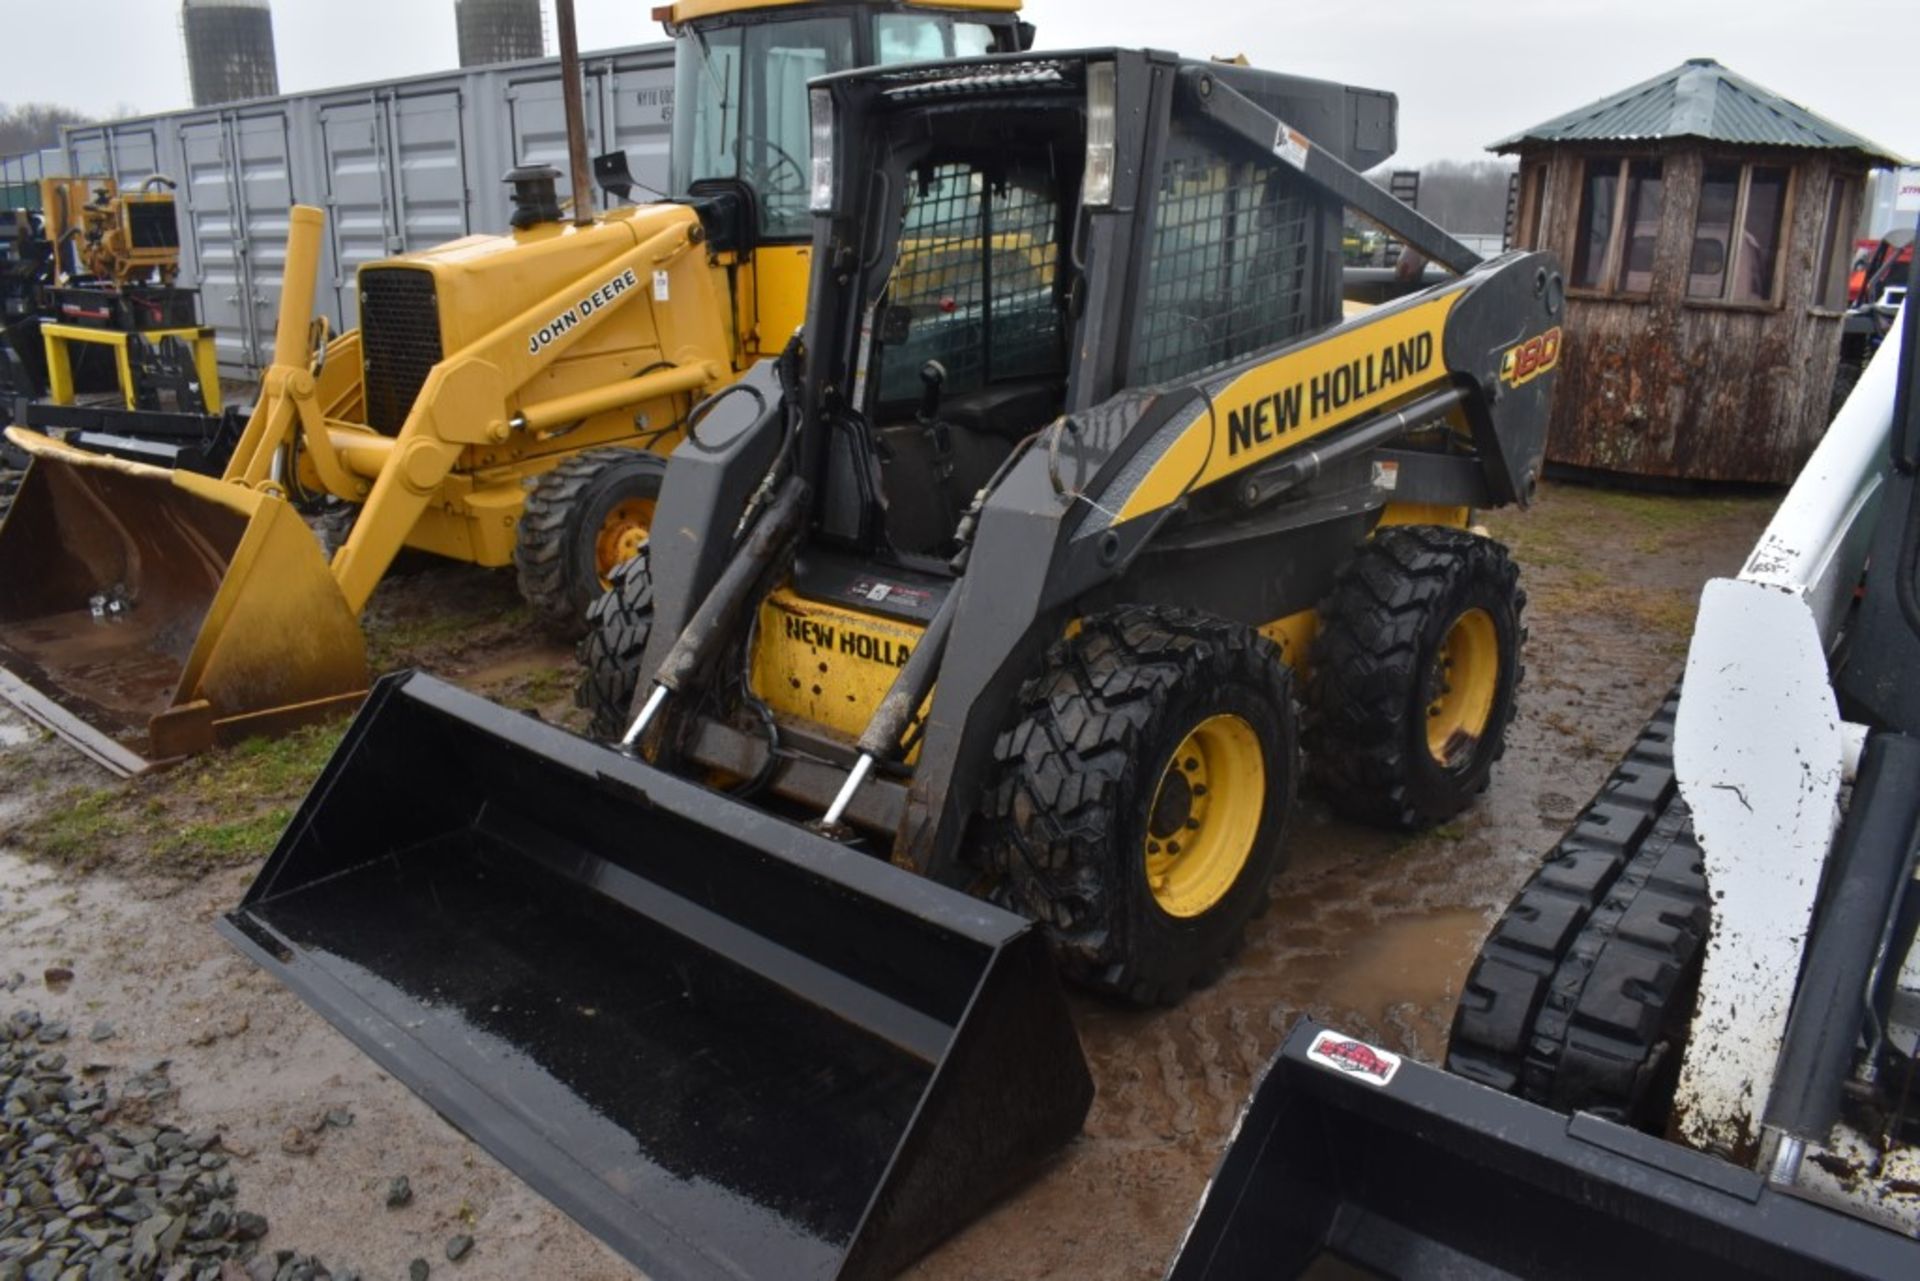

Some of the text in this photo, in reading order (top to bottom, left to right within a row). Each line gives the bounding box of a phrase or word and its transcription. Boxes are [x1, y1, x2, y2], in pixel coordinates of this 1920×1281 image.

[529, 269, 637, 353] JOHN DEERE
[1227, 330, 1434, 456] NEW HOLLAND
[785, 615, 911, 668] NEW HOLLA
